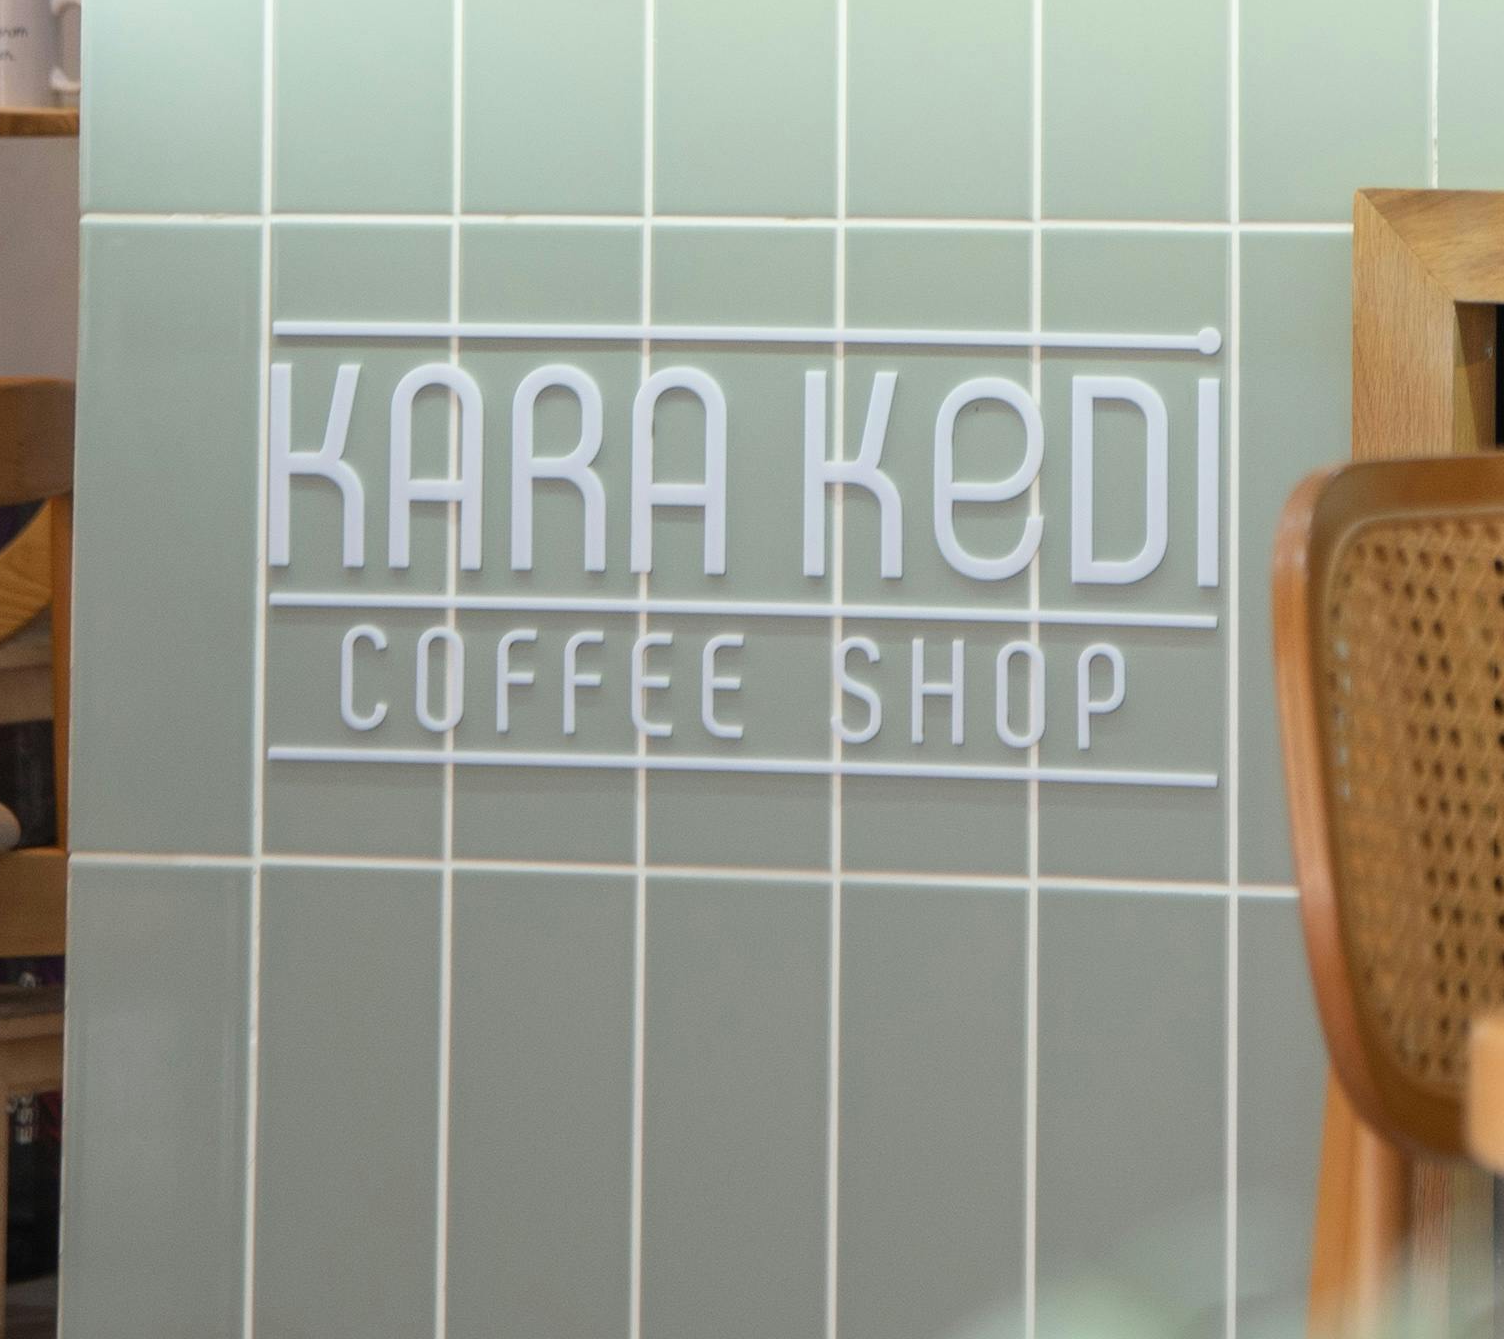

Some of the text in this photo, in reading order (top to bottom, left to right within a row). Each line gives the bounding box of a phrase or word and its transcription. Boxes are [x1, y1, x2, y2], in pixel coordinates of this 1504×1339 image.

[268, 362, 727, 575] KARA
[339, 623, 1127, 751] COFFEE SHOP
